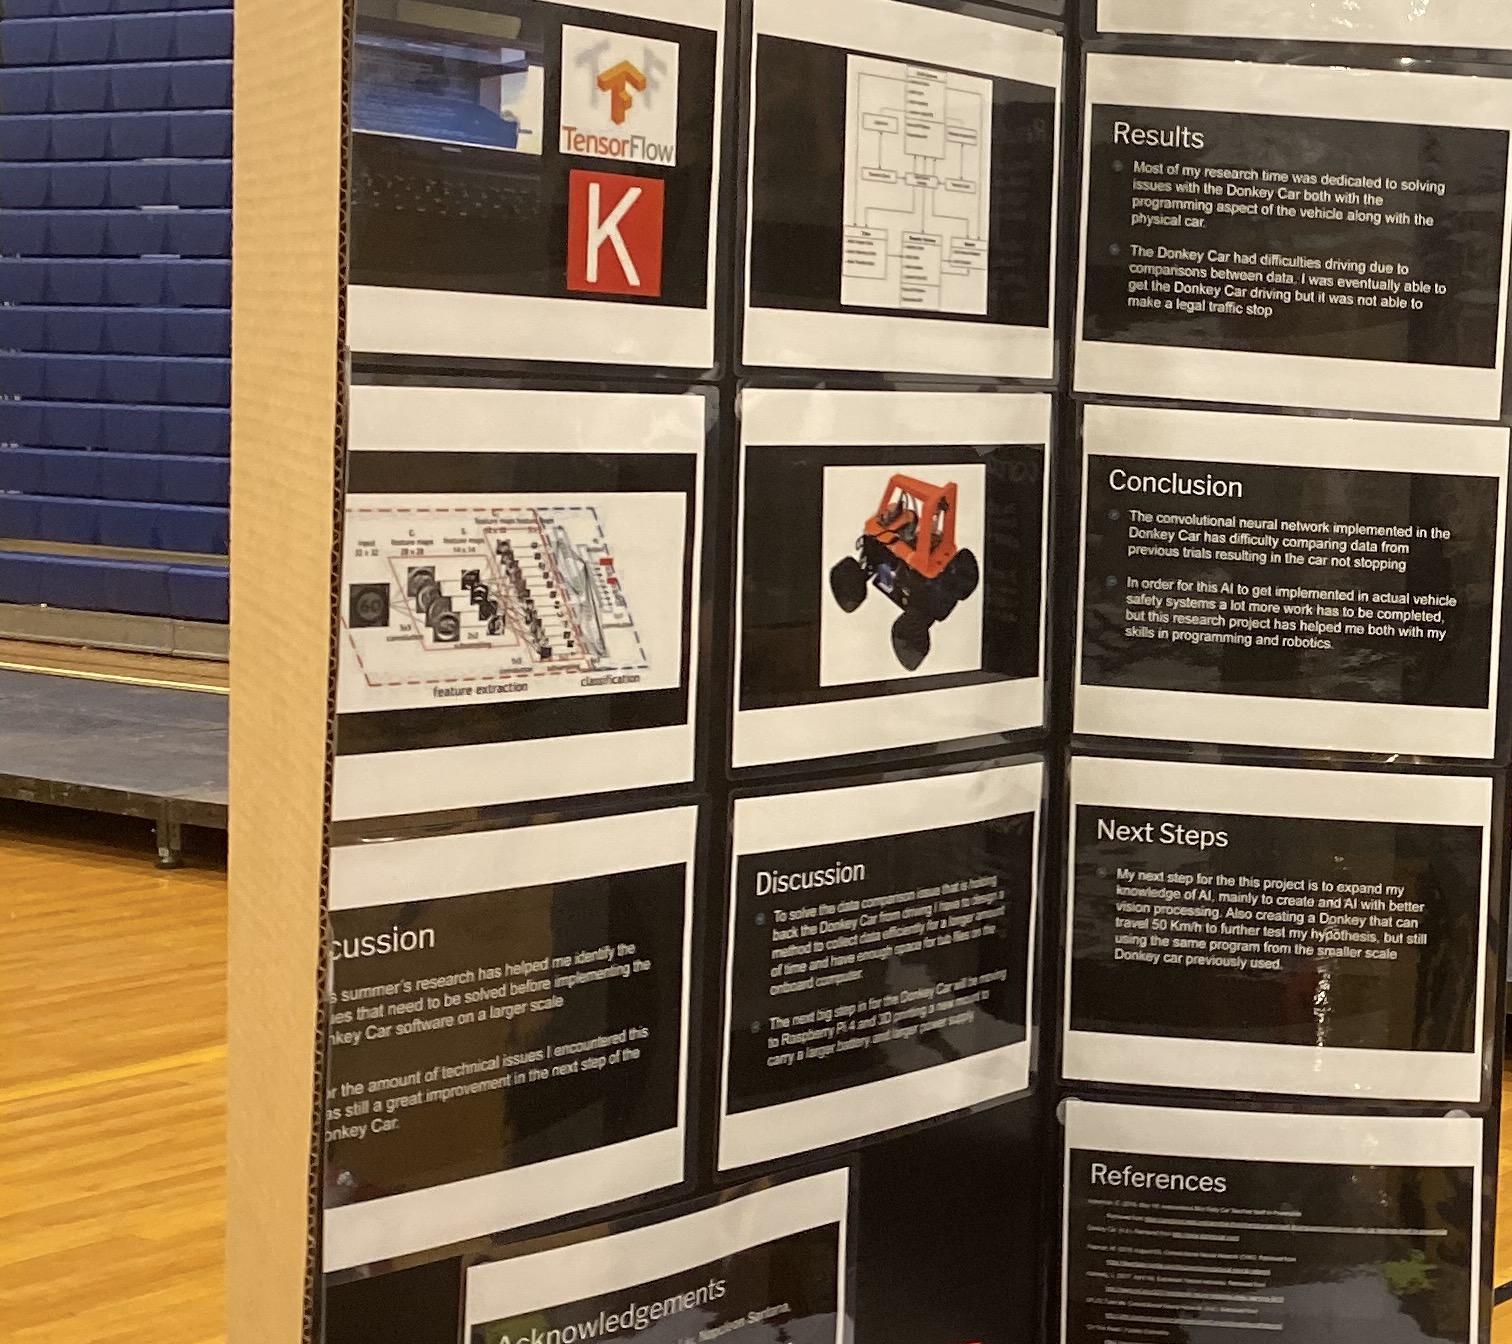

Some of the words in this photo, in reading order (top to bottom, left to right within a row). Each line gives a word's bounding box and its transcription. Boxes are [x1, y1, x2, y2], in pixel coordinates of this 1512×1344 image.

[562, 126, 674, 163] TensorFlow
[1113, 121, 1205, 150] Results
[1132, 160, 1164, 175] Most
[1166, 163, 1180, 176] of
[1181, 166, 1202, 180] my
[1261, 169, 1290, 183] time
[1291, 173, 1318, 185] was
[1384, 178, 1398, 190] to
[1174, 180, 1201, 194] with
[1203, 182, 1224, 195] the
[1277, 187, 1301, 200] Car
[1303, 188, 1332, 202] both
[1334, 191, 1361, 204] with
[1362, 192, 1384, 206] the
[586, 182, 642, 287] K
[1129, 244, 1154, 258] The
[1207, 249, 1231, 263] Car
[1233, 251, 1258, 265] had
[1368, 260, 1393, 274] due
[1395, 263, 1409, 275] to
[1109, 469, 1243, 499] Conclusion
[1128, 509, 1153, 523] The
[1155, 512, 1237, 527] convolutional
[1239, 517, 1279, 530] neural
[1281, 520, 1331, 533] network
[1332, 521, 1413, 538] implemented
[1415, 525, 1428, 538] in
[1429, 526, 1451, 540] the
[1128, 526, 1176, 543] Donkey
[1177, 528, 1201, 542] Car
[1203, 530, 1227, 543] has
[1282, 537, 1348, 553] comparing
[1349, 538, 1378, 552] data
[1380, 540, 1409, 554] from
[1127, 543, 1180, 558] previous
[1214, 548, 1268, 565] resulting
[1270, 550, 1282, 563] in
[1284, 551, 1305, 565] the
[1307, 555, 1328, 566] car
[1330, 556, 1351, 567] not
[1353, 556, 1406, 573] stopping
[1157, 626, 1169, 639] in
[1171, 630, 1252, 647] programming
[1254, 633, 1279, 646] and
[432, 685, 473, 698] feature
[476, 682, 528, 695] extraction
[1097, 818, 1154, 844] Next
[1159, 822, 1229, 851] Steps
[755, 862, 866, 897] Discussion
[330, 926, 436, 961] cussion
[329, 1029, 363, 1046] nkey
[325, 1124, 367, 1143] onkey
[1091, 1163, 1227, 1194] References
